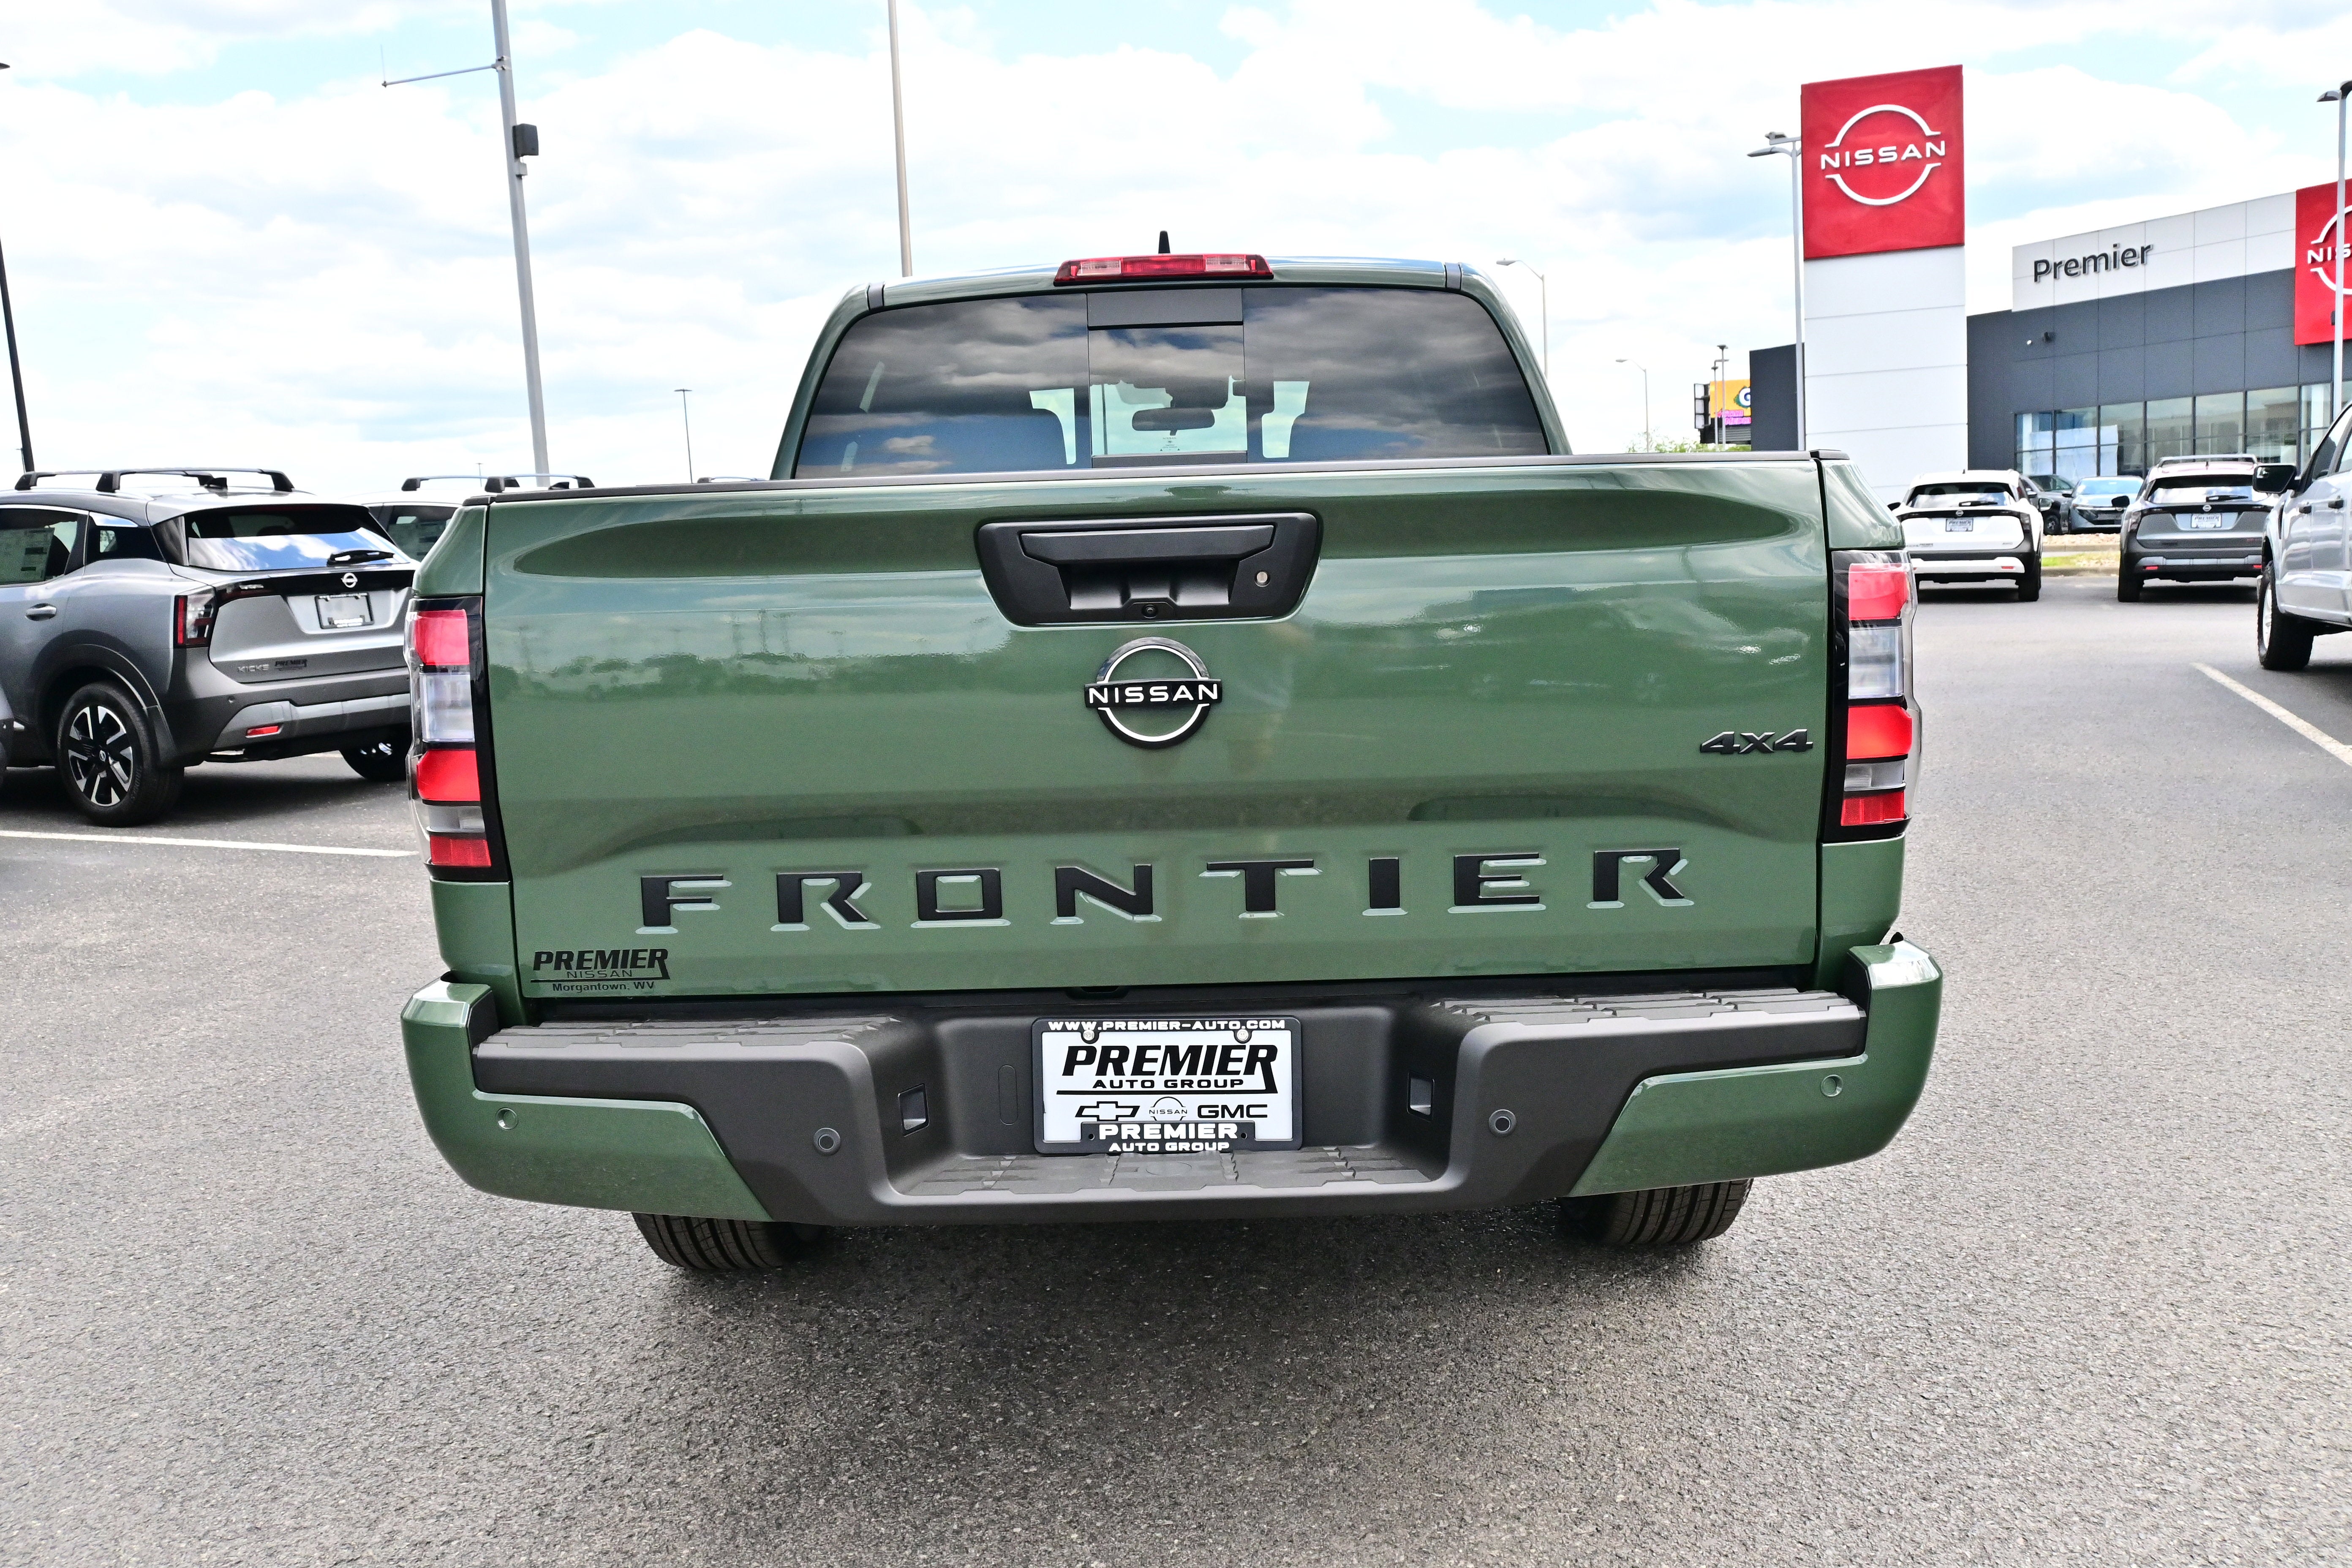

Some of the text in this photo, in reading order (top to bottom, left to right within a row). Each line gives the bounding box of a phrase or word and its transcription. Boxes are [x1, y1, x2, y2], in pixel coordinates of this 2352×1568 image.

[1821, 140, 1946, 170] NISSAN
[2034, 243, 2153, 283] Premier
[237, 664, 269, 673] KICKS
[1089, 683, 1218, 704] NISSAN
[636, 848, 1694, 934] FRONTIER
[533, 948, 670, 980] PREMIER
[567, 970, 633, 979] NISSAN
[553, 981, 655, 993] Morgantown, WV
[1048, 1020, 1285, 1031] WWW.PREMIER-AUTO.COM
[1062, 1045, 1278, 1094] PREMIER
[1093, 1079, 1244, 1089] AUTO GROUP
[1198, 1104, 1268, 1119] GMC
[1099, 1123, 1238, 1140] PREMIER
[1108, 1141, 1230, 1152] AUTO GROUP
